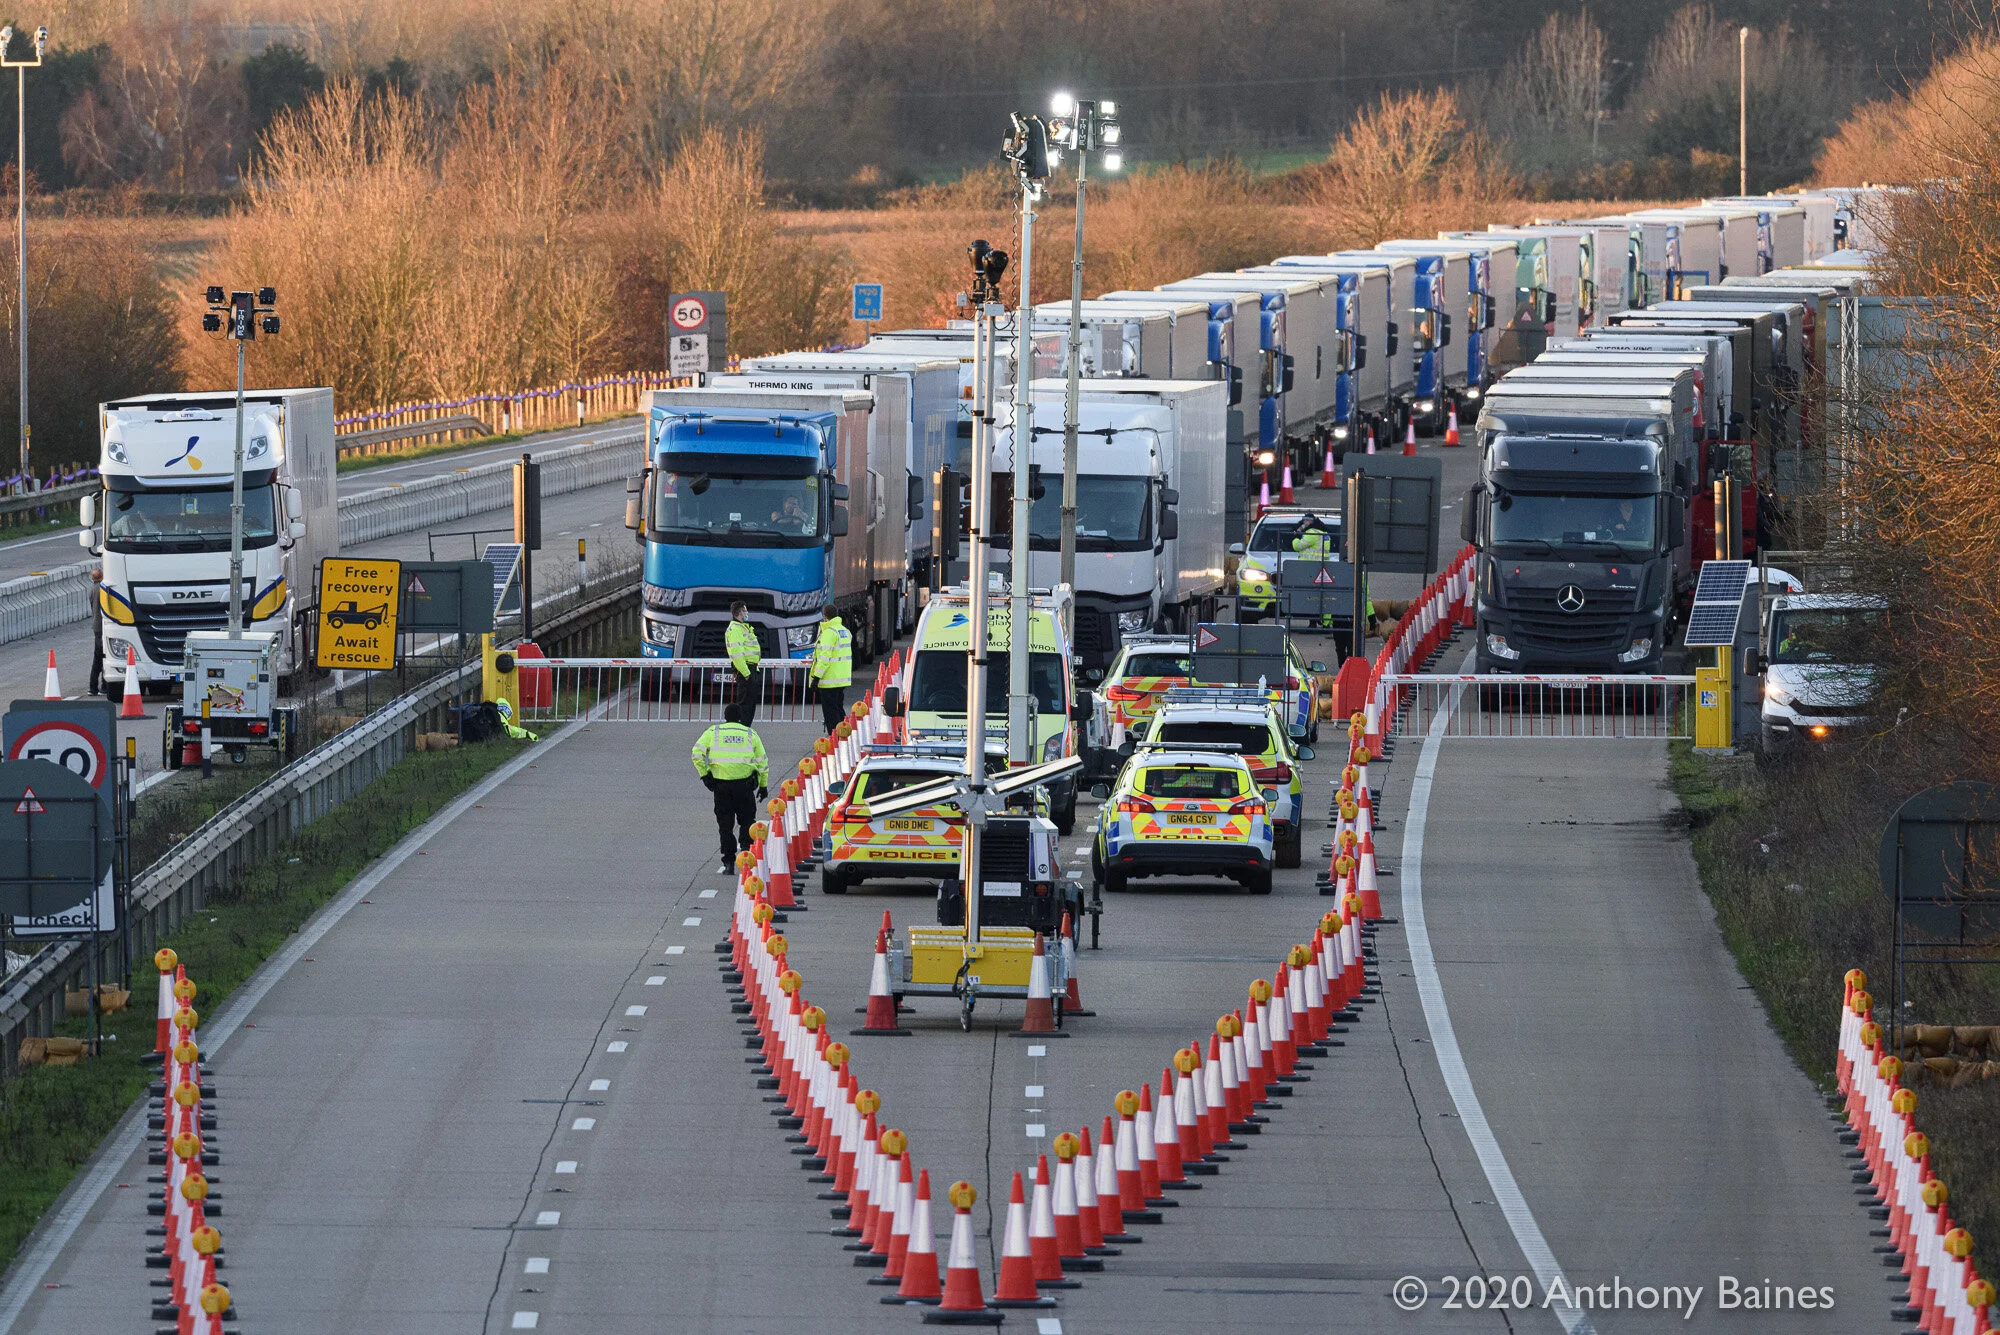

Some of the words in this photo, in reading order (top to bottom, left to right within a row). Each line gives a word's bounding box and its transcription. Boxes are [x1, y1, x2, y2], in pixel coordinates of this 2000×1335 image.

[1079, 118, 1087, 146] TRIME
[677, 308, 702, 321] 50
[237, 309, 245, 336] TRIME
[749, 381, 788, 390] THERMO
[790, 382, 813, 390] KING
[345, 566, 378, 579] Free
[172, 590, 213, 599] DAF
[327, 583, 393, 597] recovery
[335, 635, 379, 649] Await
[330, 652, 380, 663] rescue
[723, 735, 744, 743] POLICE
[889, 820, 909, 829] GN18
[911, 820, 929, 829] DME
[1170, 816, 1194, 824] GN64
[1196, 816, 1213, 824] CSY
[1145, 834, 1239, 842] POLICE
[868, 850, 947, 860] POLICE
[34, 911, 94, 926] check
